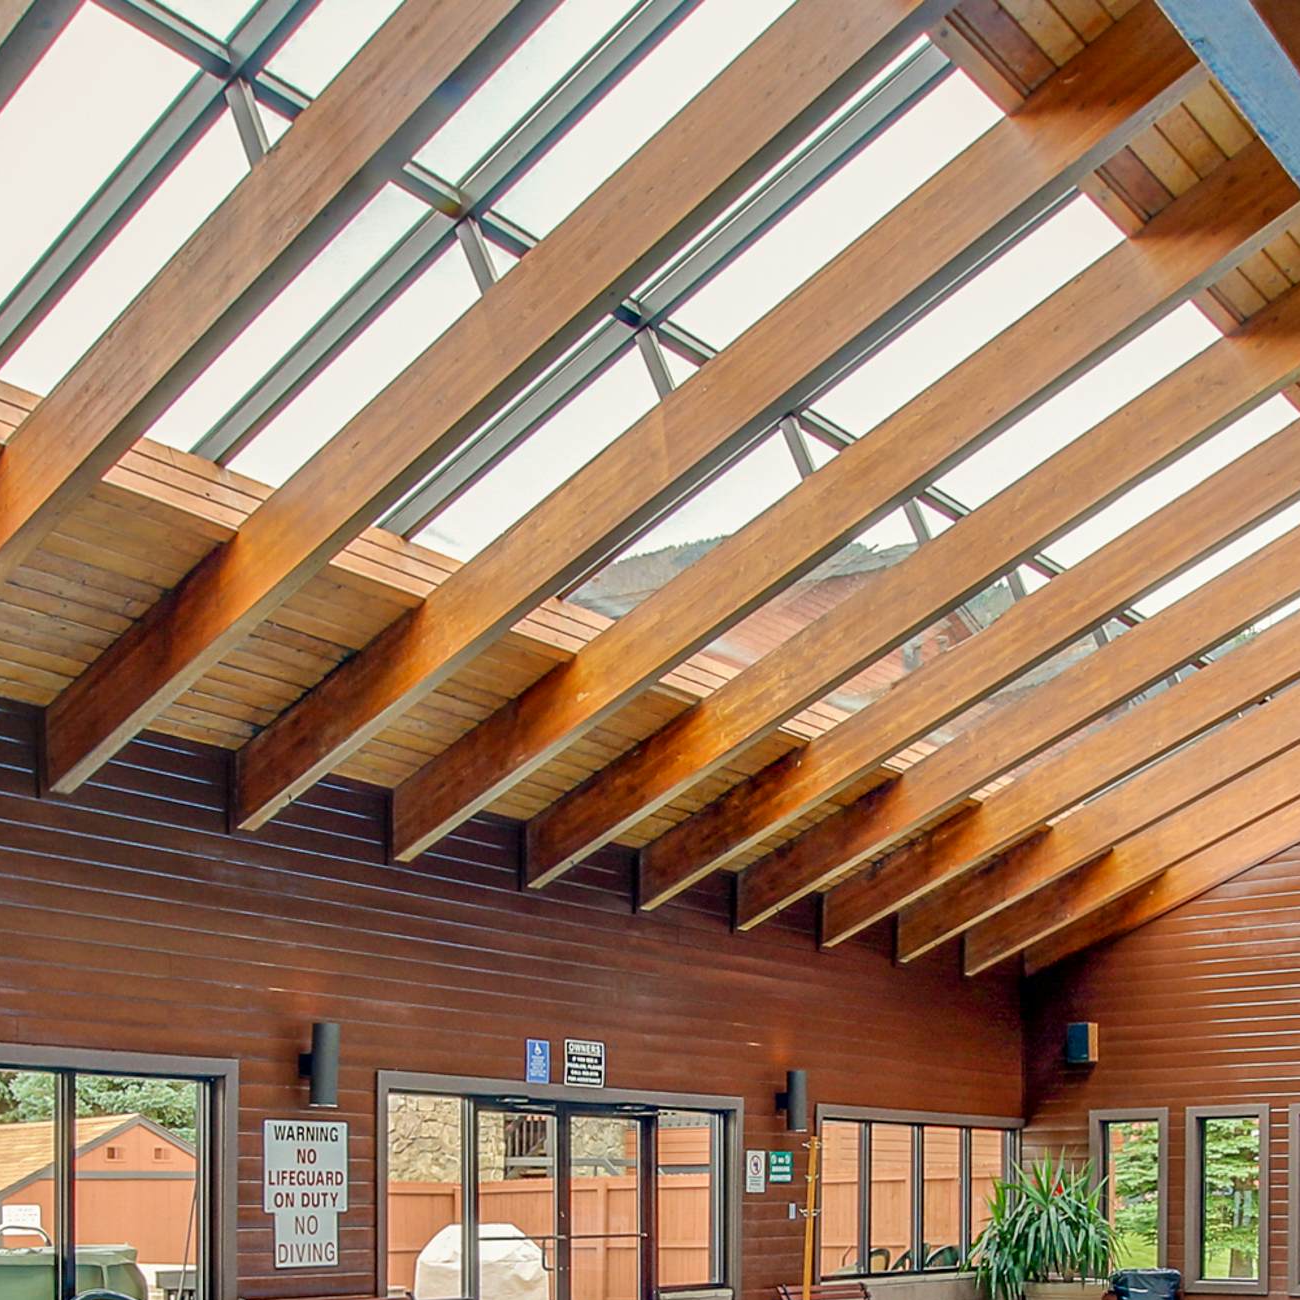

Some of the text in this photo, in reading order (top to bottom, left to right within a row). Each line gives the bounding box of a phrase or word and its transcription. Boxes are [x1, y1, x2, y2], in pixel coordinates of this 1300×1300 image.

[568, 1042, 601, 1054] OWNERS
[273, 1125, 339, 1142] WARNING
[296, 1148, 317, 1164] NO
[268, 1170, 344, 1186] LIFEGUARD
[273, 1192, 339, 1208] ON DUTY
[294, 1215, 318, 1235] NO
[278, 1242, 335, 1264] DIVING
